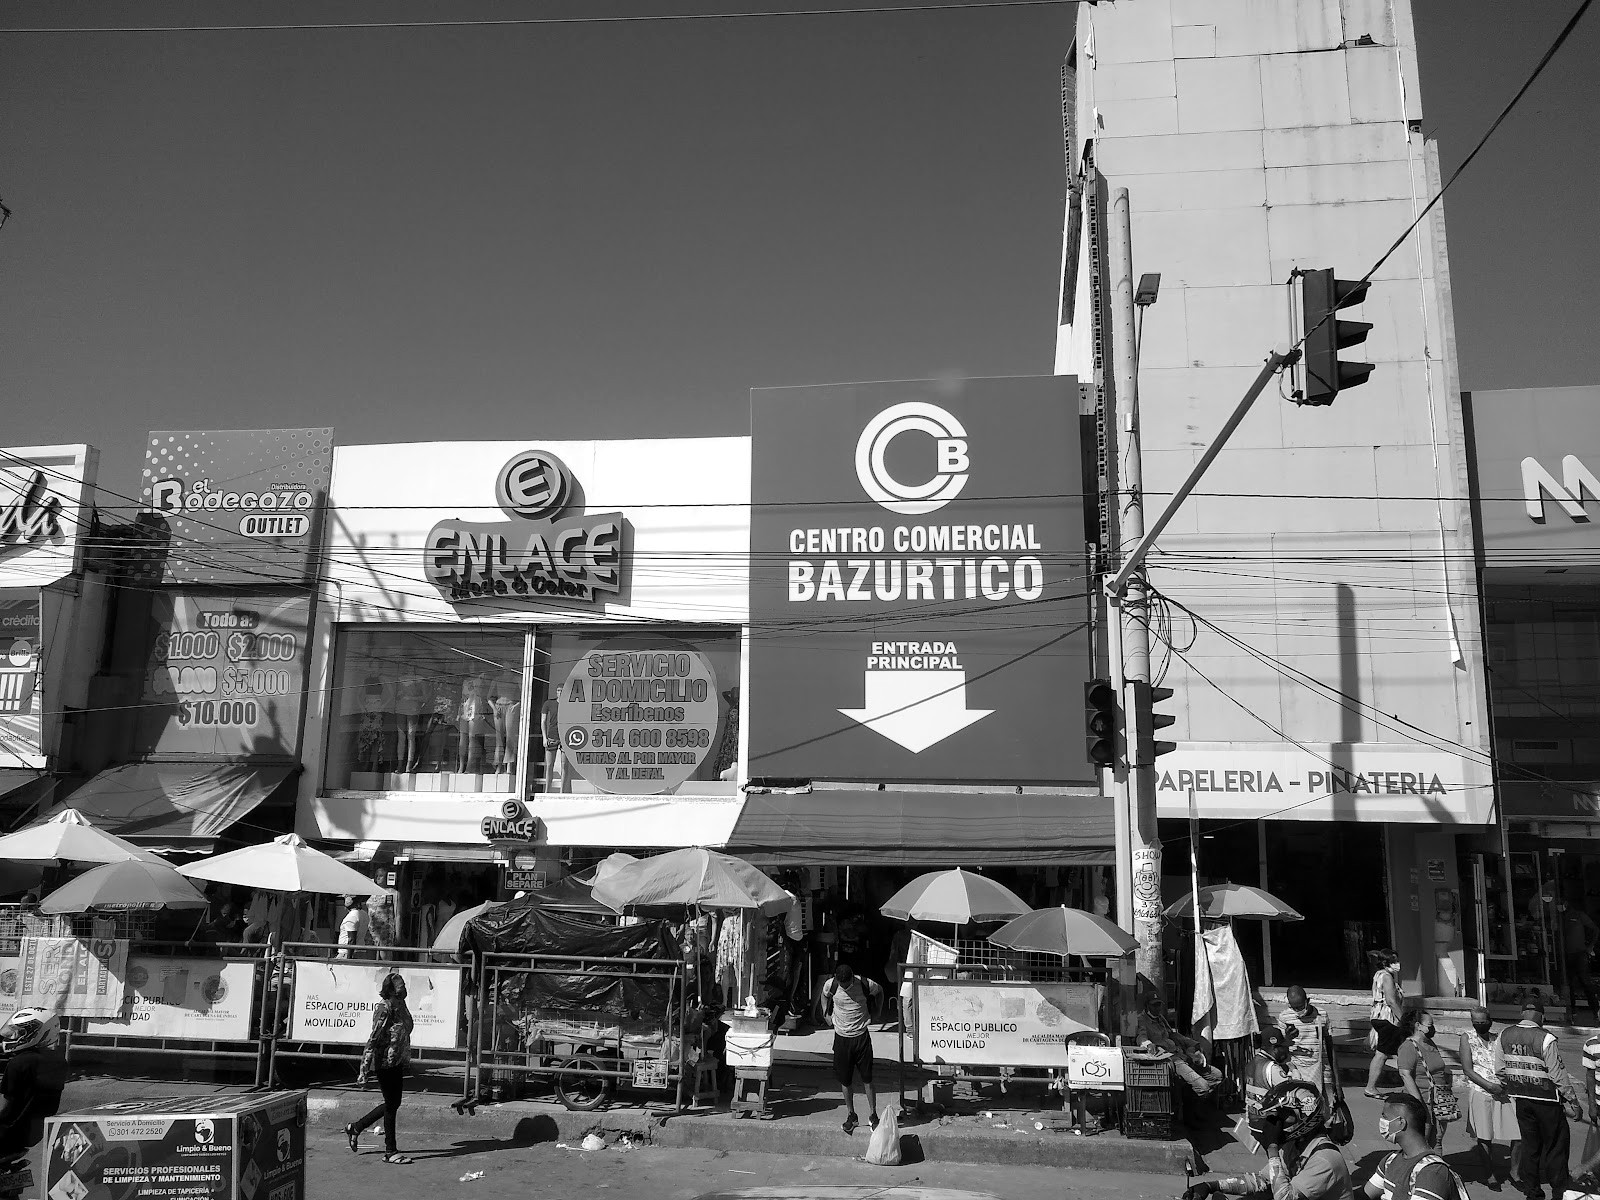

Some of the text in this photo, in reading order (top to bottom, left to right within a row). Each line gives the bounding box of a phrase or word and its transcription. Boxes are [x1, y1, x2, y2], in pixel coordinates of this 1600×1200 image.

[192, 478, 211, 494] el
[271, 484, 307, 492] Distribuidora
[246, 518, 303, 534] OUTLET
[789, 524, 1041, 555] CENTRO COMERCIAL
[433, 523, 618, 578] ENLACE
[787, 556, 1044, 602] BAZURTICO
[203, 612, 237, 627] Todo
[227, 632, 297, 662] $2.000
[871, 641, 958, 656] ENTRADA
[588, 653, 691, 678] SERVICIO
[867, 656, 963, 670] PRINCIPAL
[222, 667, 290, 695] $5.000
[569, 679, 708, 703] A DOMICILIO
[178, 700, 258, 727] $10.000
[591, 703, 685, 722] Escríbenos
[592, 728, 710, 748] 314 600 8598
[576, 752, 697, 765] VENTAS AL POR MAYOR
[605, 767, 665, 780] Y AL DETAL
[1154, 769, 1284, 793] APELERIA
[1308, 770, 1448, 796] PINATERIA
[482, 820, 534, 837] ENLACE
[507, 880, 544, 889] SEPARE
[512, 873, 538, 881] PLAN
[27, 956, 35, 964] DE
[26, 966, 34, 974] 27
[24, 975, 33, 992] ESTE
[77, 970, 86, 986] EL
[305, 1001, 344, 1012] ESPACIO
[304, 1018, 356, 1028] MOVILIDAD
[930, 1022, 1018, 1033] ESPACIO PUBLICO
[930, 1039, 986, 1049] MOVILIDAD
[106, 1119, 131, 1127] Servicio
[116, 1128, 129, 1136] 301
[131, 1128, 144, 1136] 472
[176, 1145, 200, 1153] Limpio
[103, 1165, 221, 1175] SERVICIOS PROFESIONALES
[103, 1176, 113, 1184] DE
[158, 1174, 221, 1182] MANTENIMIENTO
